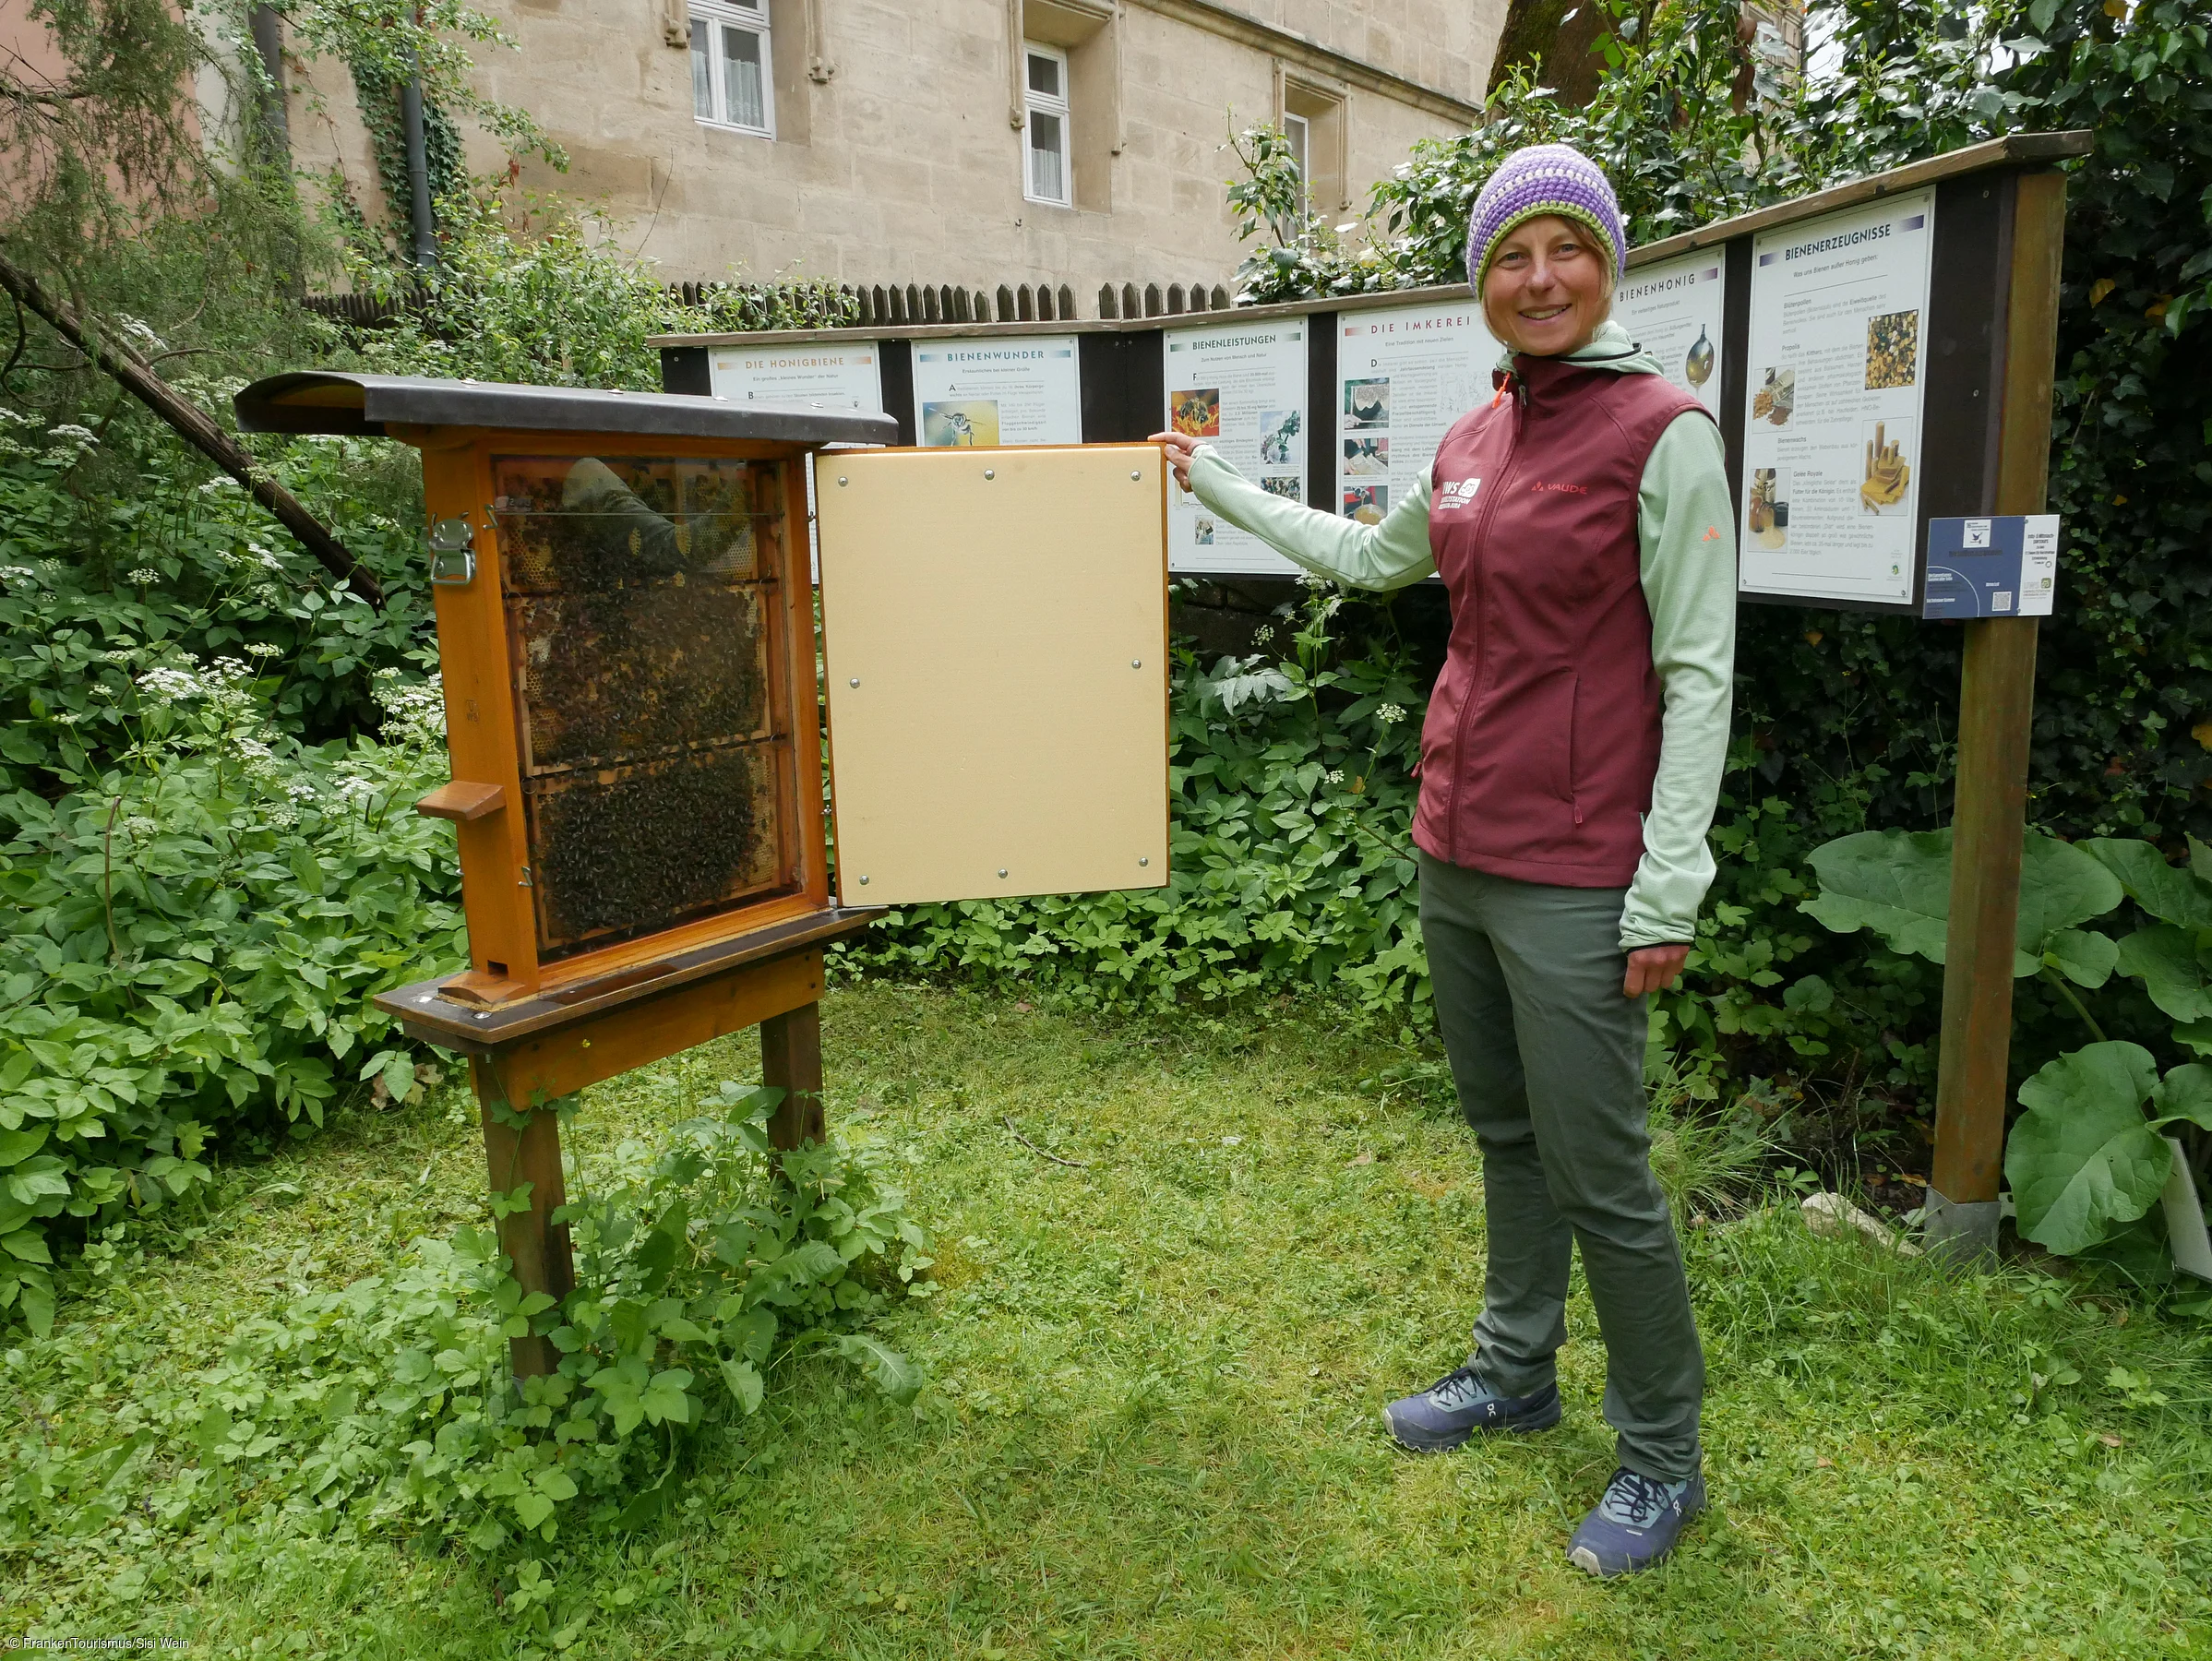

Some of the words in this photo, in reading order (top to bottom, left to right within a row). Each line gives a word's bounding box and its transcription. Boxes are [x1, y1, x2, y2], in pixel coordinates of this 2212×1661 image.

[1785, 223, 1891, 260] BIENENERZEUGNISSE
[1813, 265, 1829, 274] Bienen
[1831, 261, 1845, 270] außer
[1846, 258, 1860, 267] Honig
[1861, 255, 1878, 264] geben:
[1620, 273, 1694, 302] BIENENHONIG
[1784, 298, 1811, 308] Blütenpollen
[1371, 324, 1393, 333] DIE
[1405, 317, 1470, 330] IMKEREI
[1192, 334, 1276, 350] BIENENLEISTUNGEN
[746, 361, 764, 369] DIE
[771, 357, 844, 368] HONIGBIENE
[948, 351, 1045, 362] BIENENWUNDER
[1548, 484, 1588, 495] VAUDE
